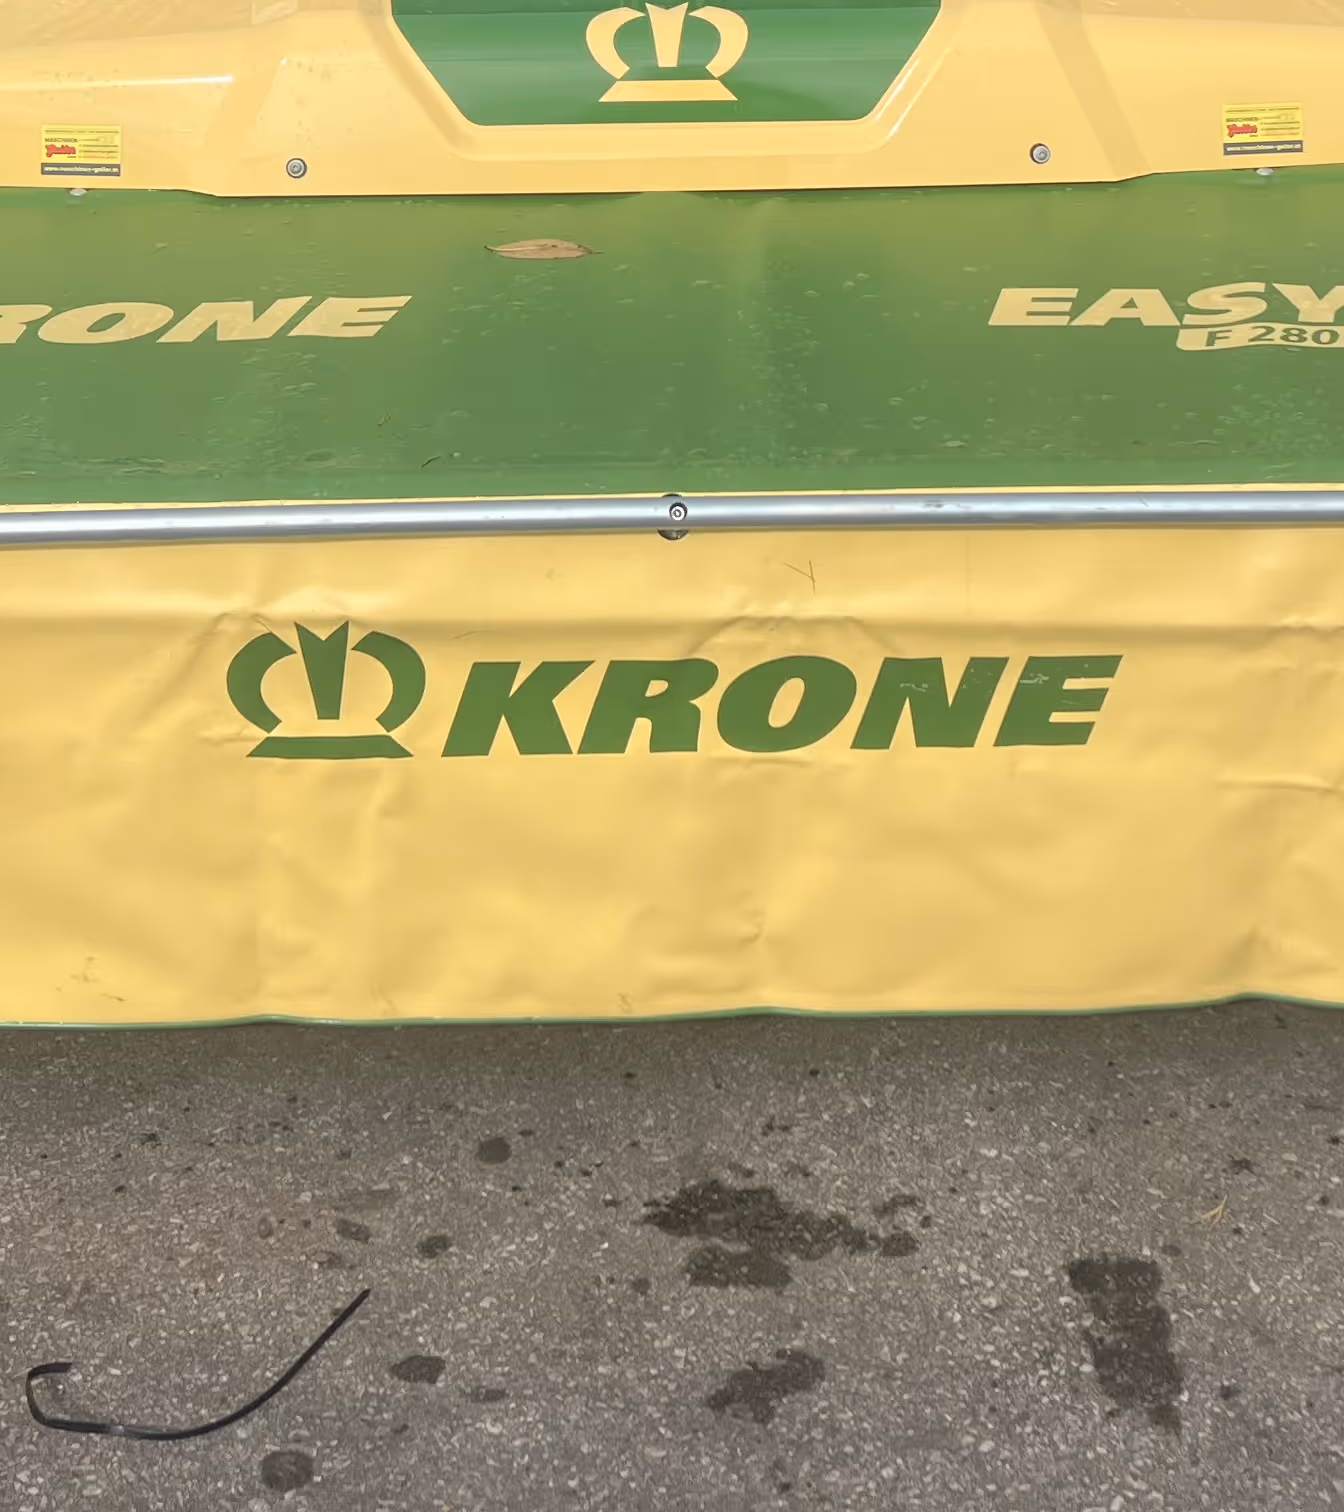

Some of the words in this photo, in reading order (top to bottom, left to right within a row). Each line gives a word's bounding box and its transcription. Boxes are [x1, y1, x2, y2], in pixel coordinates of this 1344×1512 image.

[1205, 329, 1234, 348] F
[1247, 324, 1342, 346] 280
[440, 653, 1126, 756] KRONE
